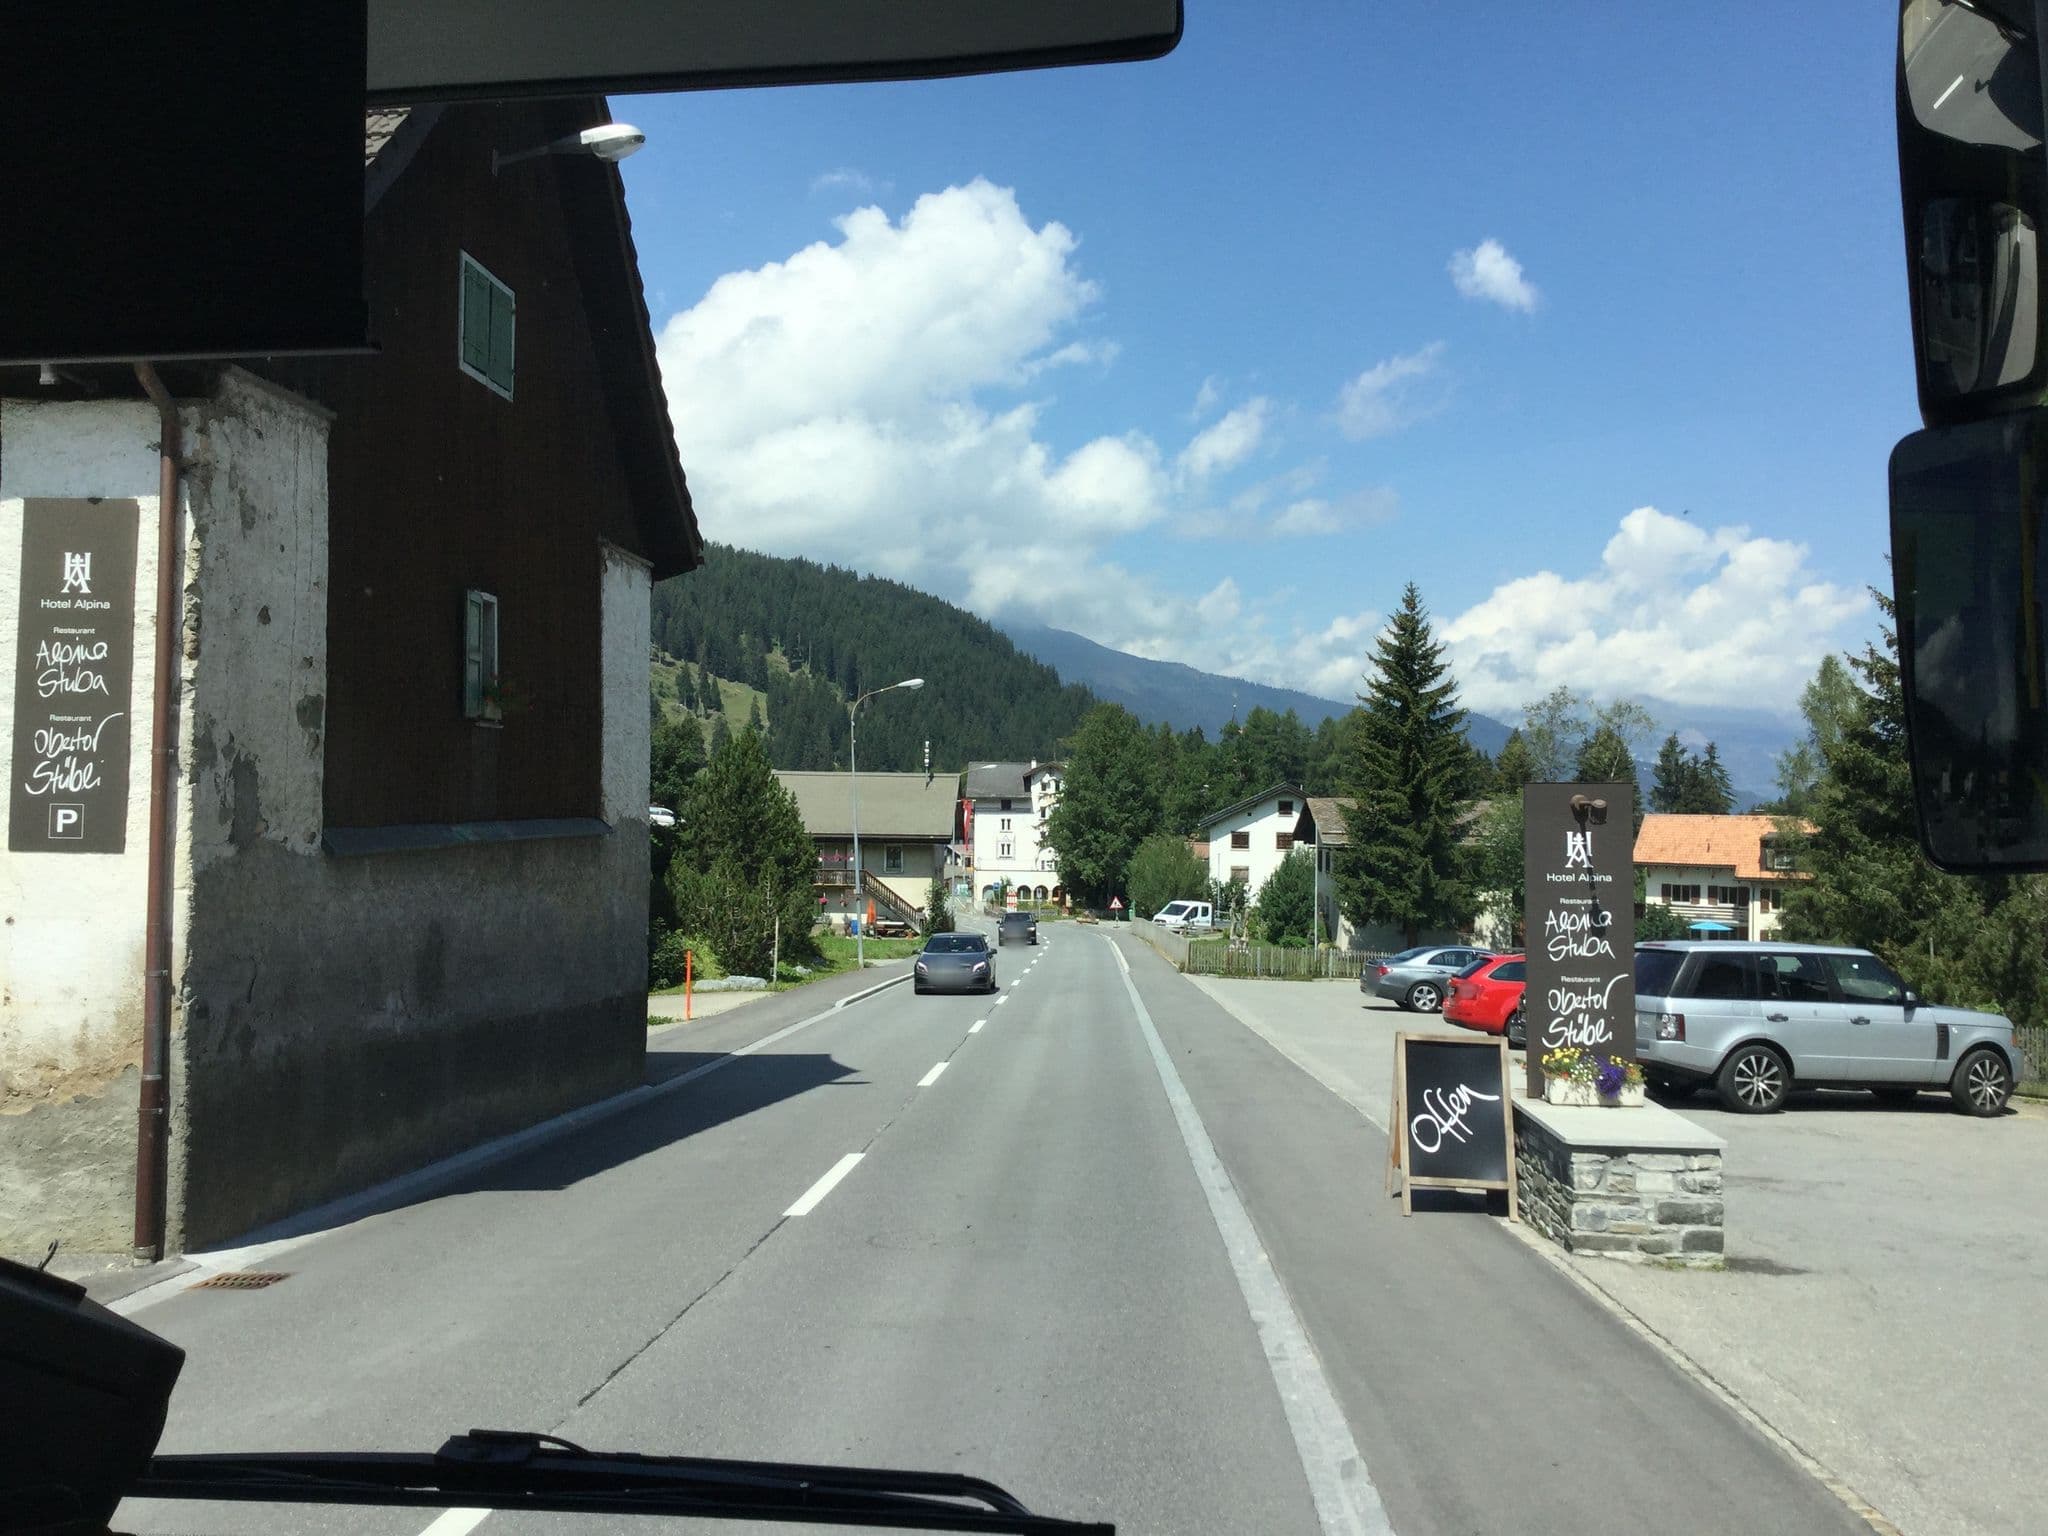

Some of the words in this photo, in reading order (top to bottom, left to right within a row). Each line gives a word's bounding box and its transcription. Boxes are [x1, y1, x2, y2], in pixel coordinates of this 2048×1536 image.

[40, 599, 71, 609] Hotel
[73, 599, 111, 611] Alpina
[53, 626, 95, 635] Restaurant
[35, 636, 108, 671] Alpina
[37, 667, 109, 698] Stuba
[49, 713, 92, 722] Restaurant
[34, 712, 124, 758] Obertor
[24, 756, 105, 795] Stübli
[56, 809, 78, 833] P
[1546, 873, 1576, 882] Hotel
[1578, 873, 1613, 883] Alpina
[1559, 897, 1600, 905] Restaurat
[1547, 933, 1616, 962] Stuba
[1560, 975, 1601, 983] Restaurant
[1547, 973, 1629, 1016] Obertor
[1541, 1012, 1615, 1048] Stübli
[1411, 1083, 1500, 1153] Offen
